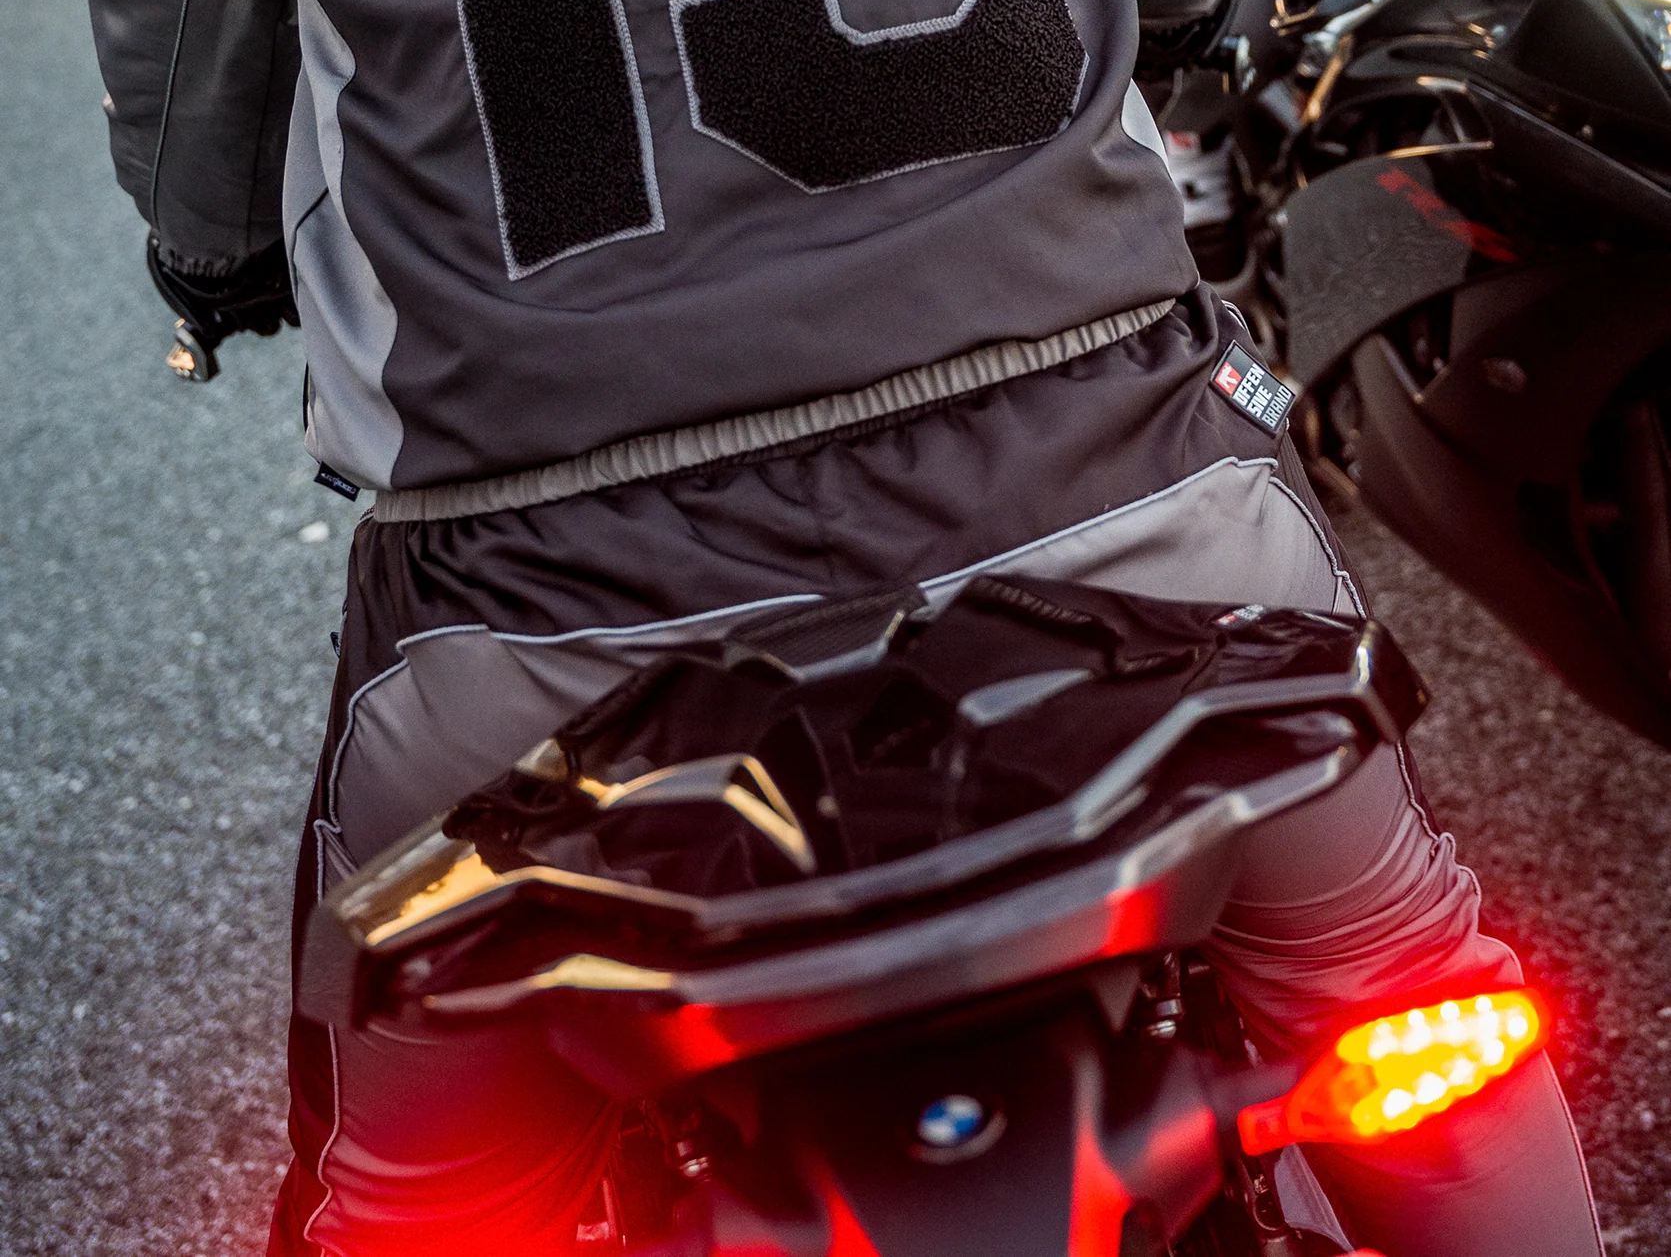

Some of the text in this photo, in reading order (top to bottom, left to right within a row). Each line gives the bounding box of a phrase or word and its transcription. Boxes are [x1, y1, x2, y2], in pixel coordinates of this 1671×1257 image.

[1232, 363, 1265, 407] OFFEN
[1246, 385, 1272, 417] SIVE
[1262, 386, 1292, 428] BRAND
